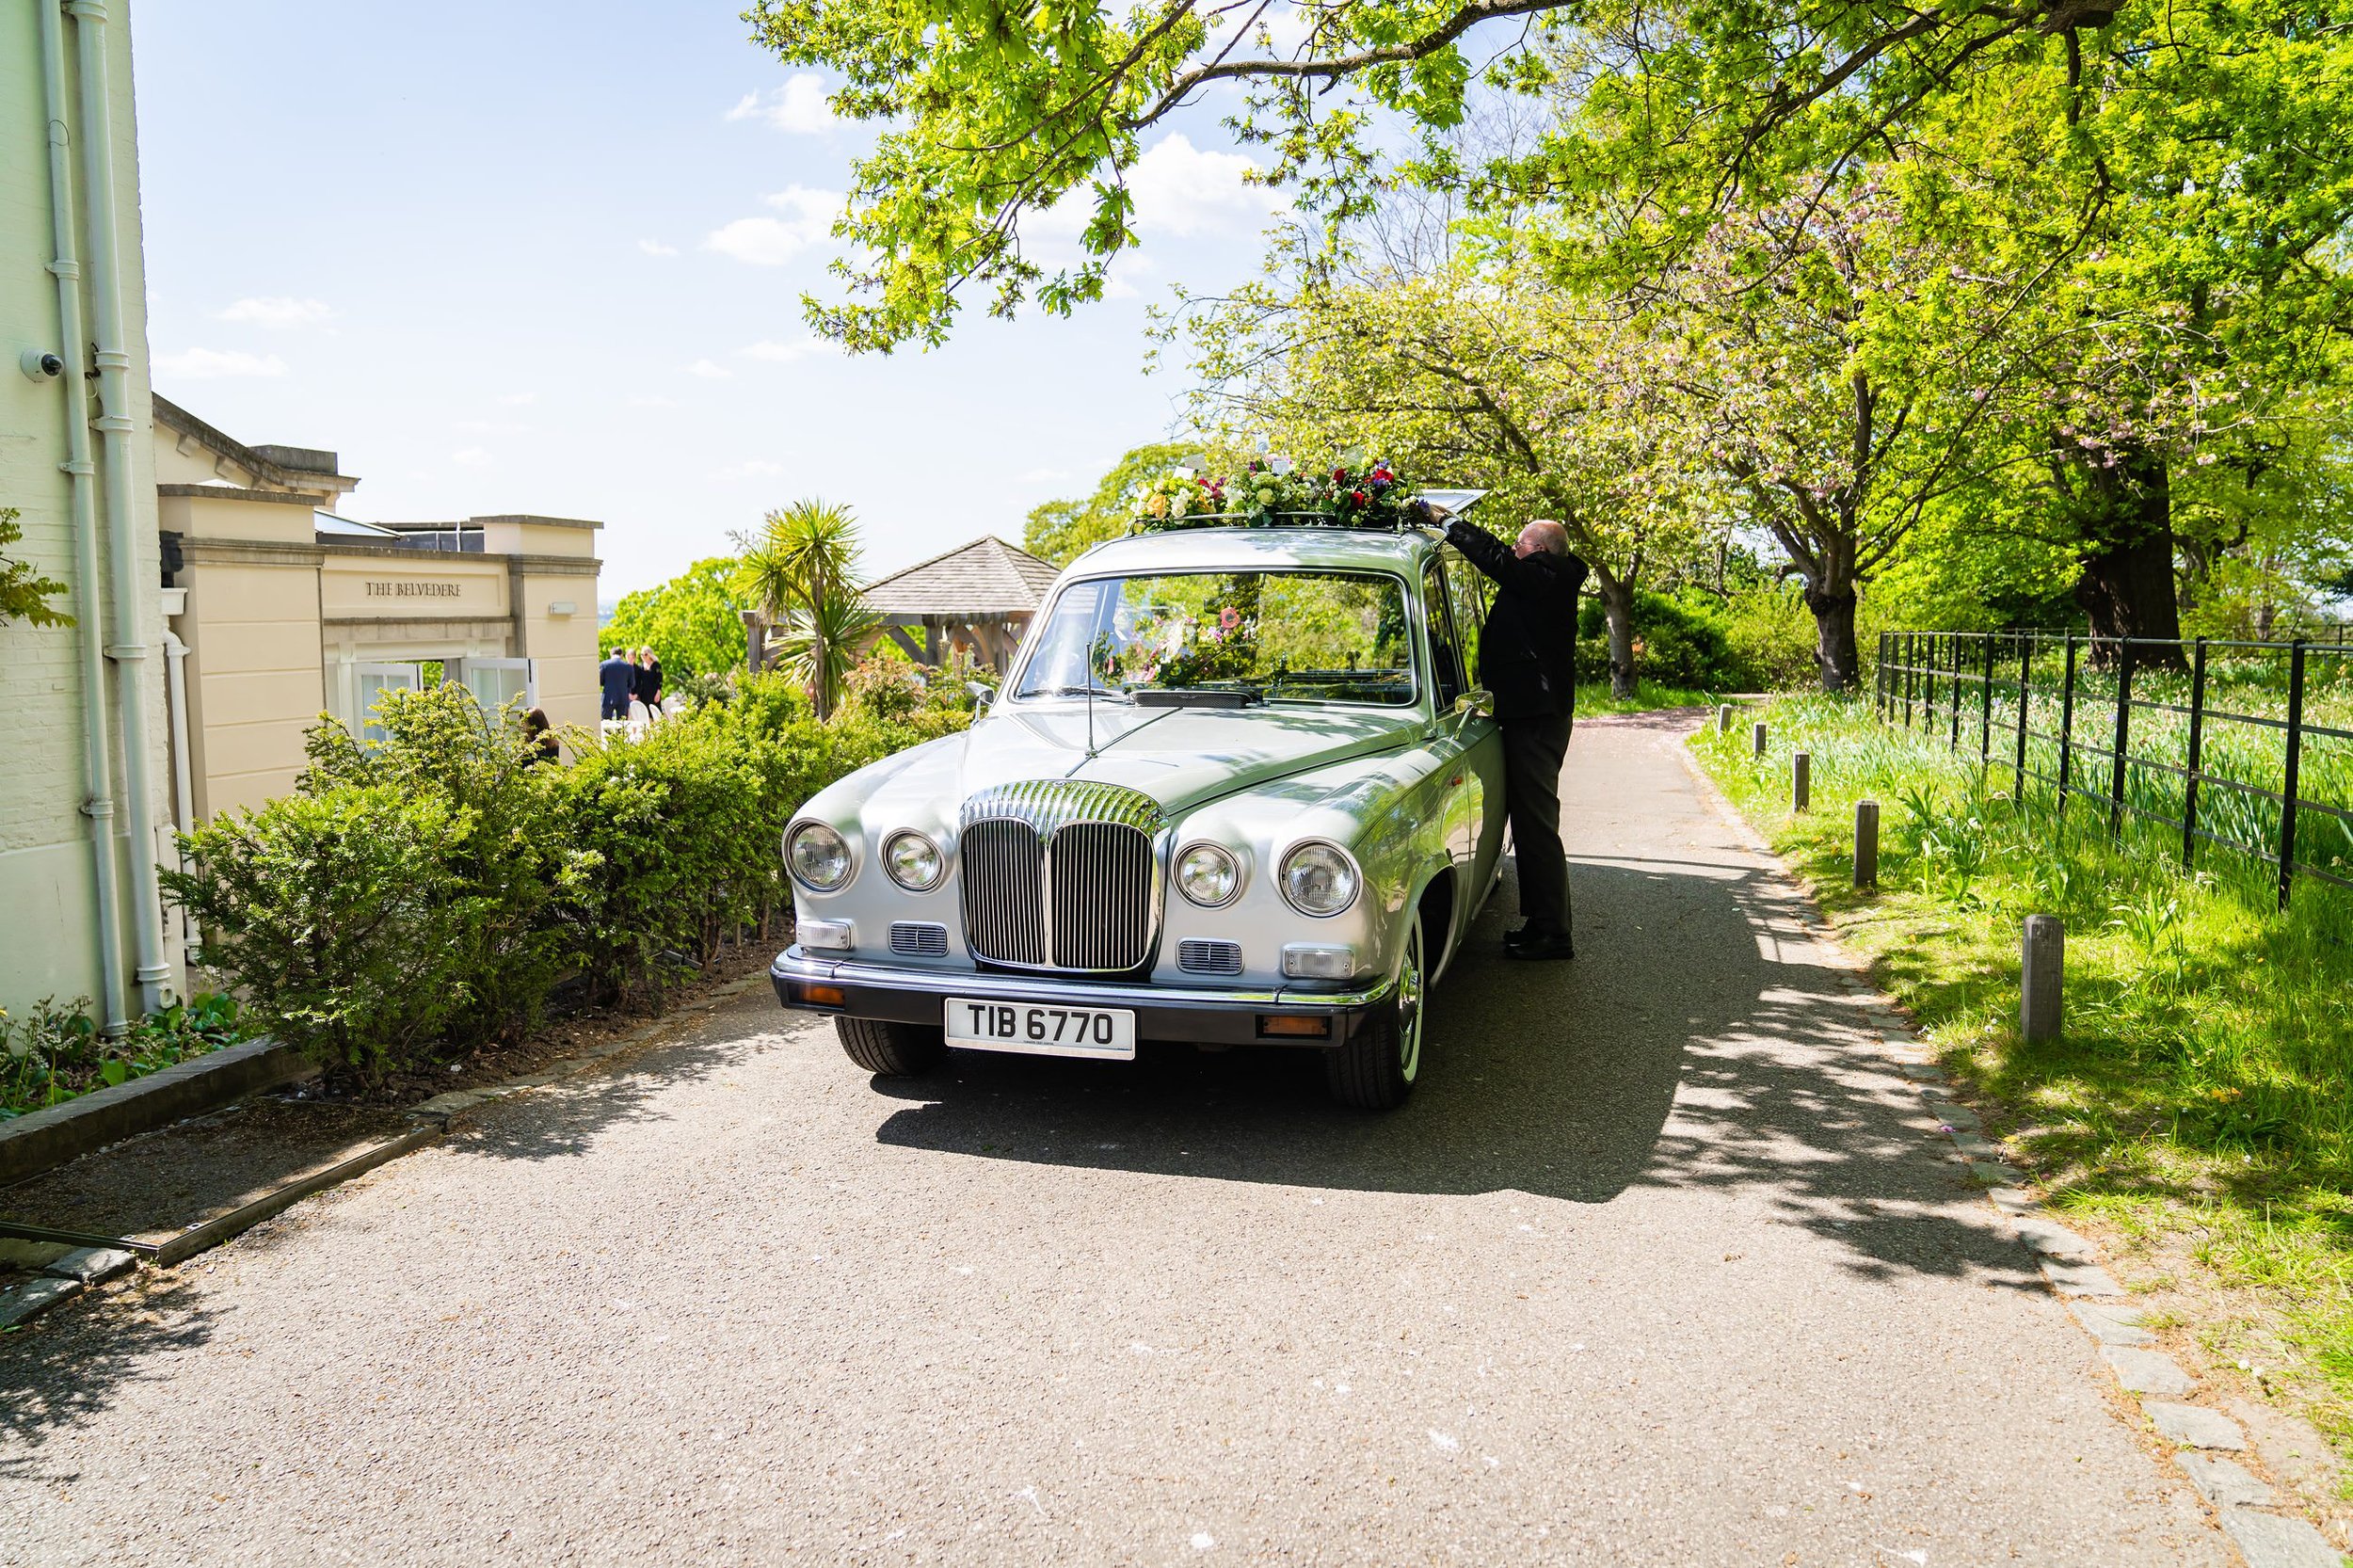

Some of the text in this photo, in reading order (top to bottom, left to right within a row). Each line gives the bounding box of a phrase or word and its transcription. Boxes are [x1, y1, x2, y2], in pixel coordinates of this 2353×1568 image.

[365, 583, 461, 597] THE BELVEDERE
[968, 1004, 1113, 1045] TIB 6770
